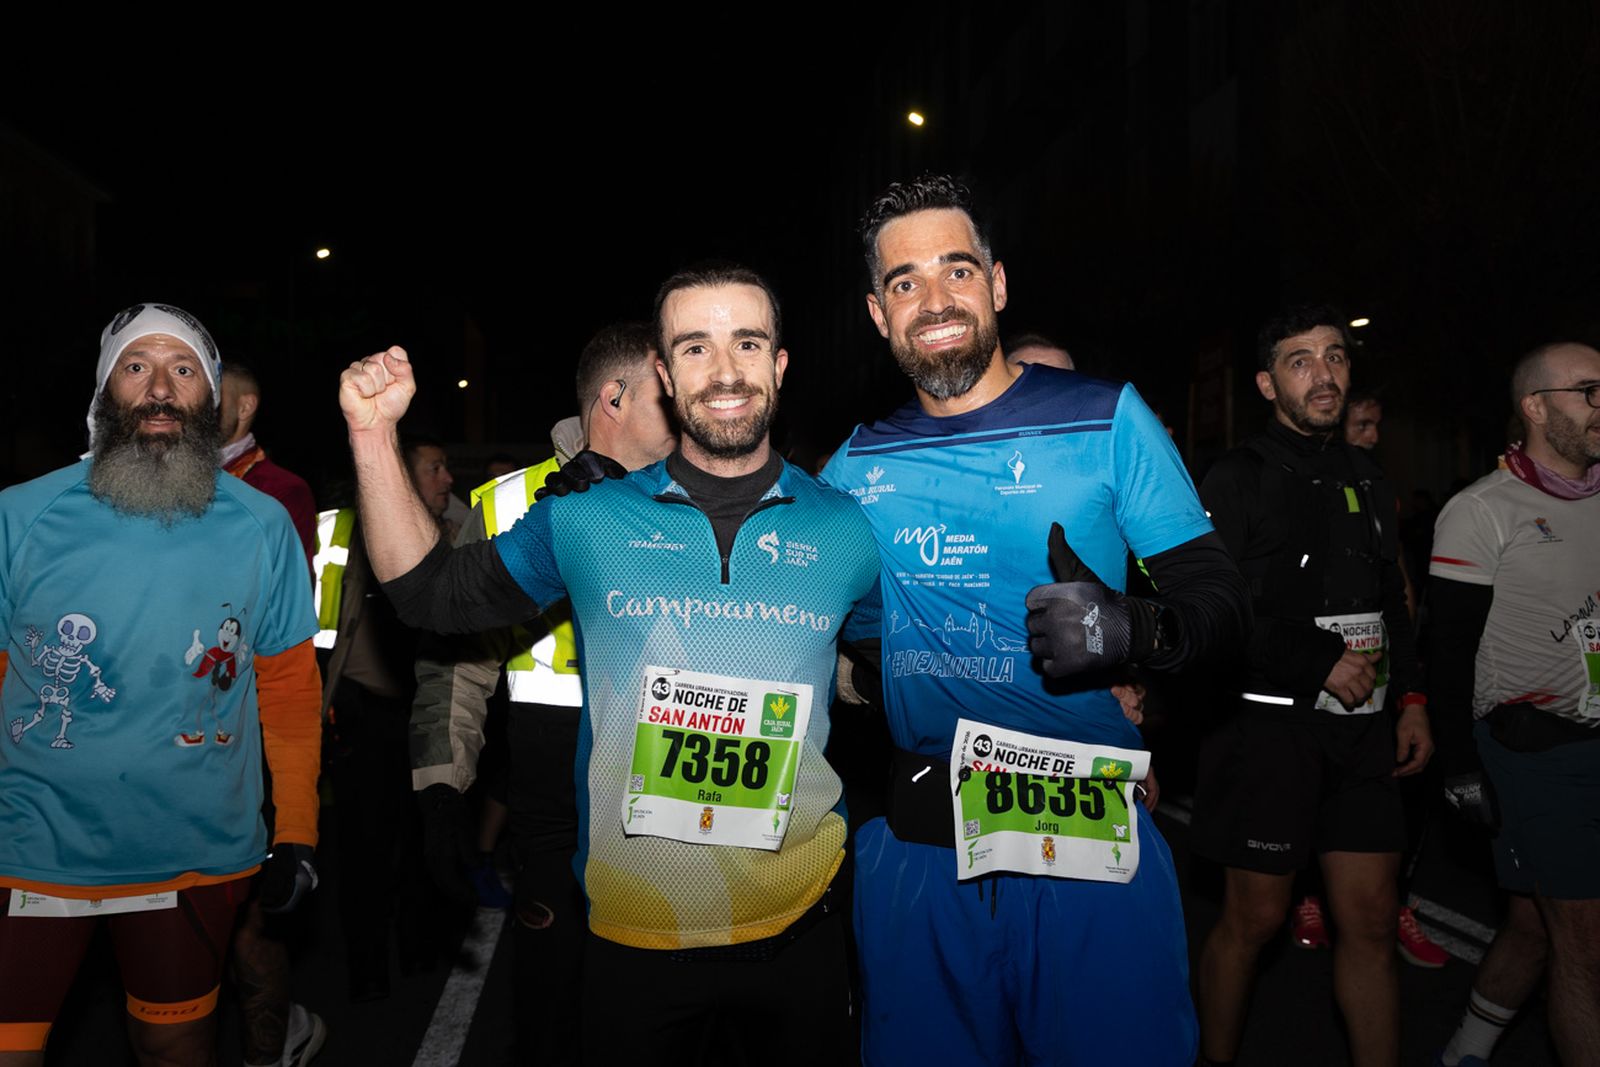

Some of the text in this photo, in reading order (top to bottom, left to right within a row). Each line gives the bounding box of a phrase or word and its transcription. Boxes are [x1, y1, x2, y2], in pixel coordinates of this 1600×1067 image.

[868, 484, 897, 494] RURAL
[945, 534, 975, 543] MEDIA
[785, 541, 818, 553] SIERRA
[943, 545, 988, 554] MARATÓN
[785, 549, 819, 562] SUR DE
[940, 555, 963, 566] JAÉN
[1343, 626, 1371, 636] NOCHE
[1372, 624, 1381, 634] DE
[653, 681, 748, 713] 43 NOCHE DE
[648, 705, 746, 735] SAN ANTÓN
[660, 729, 771, 790] 7358
[973, 738, 1075, 775] 43 NOCHE DE
[697, 788, 722, 802] Rafa
[985, 771, 1106, 820] 8635
[1035, 820, 1059, 834] Jorg
[139, 1004, 199, 1016] land
